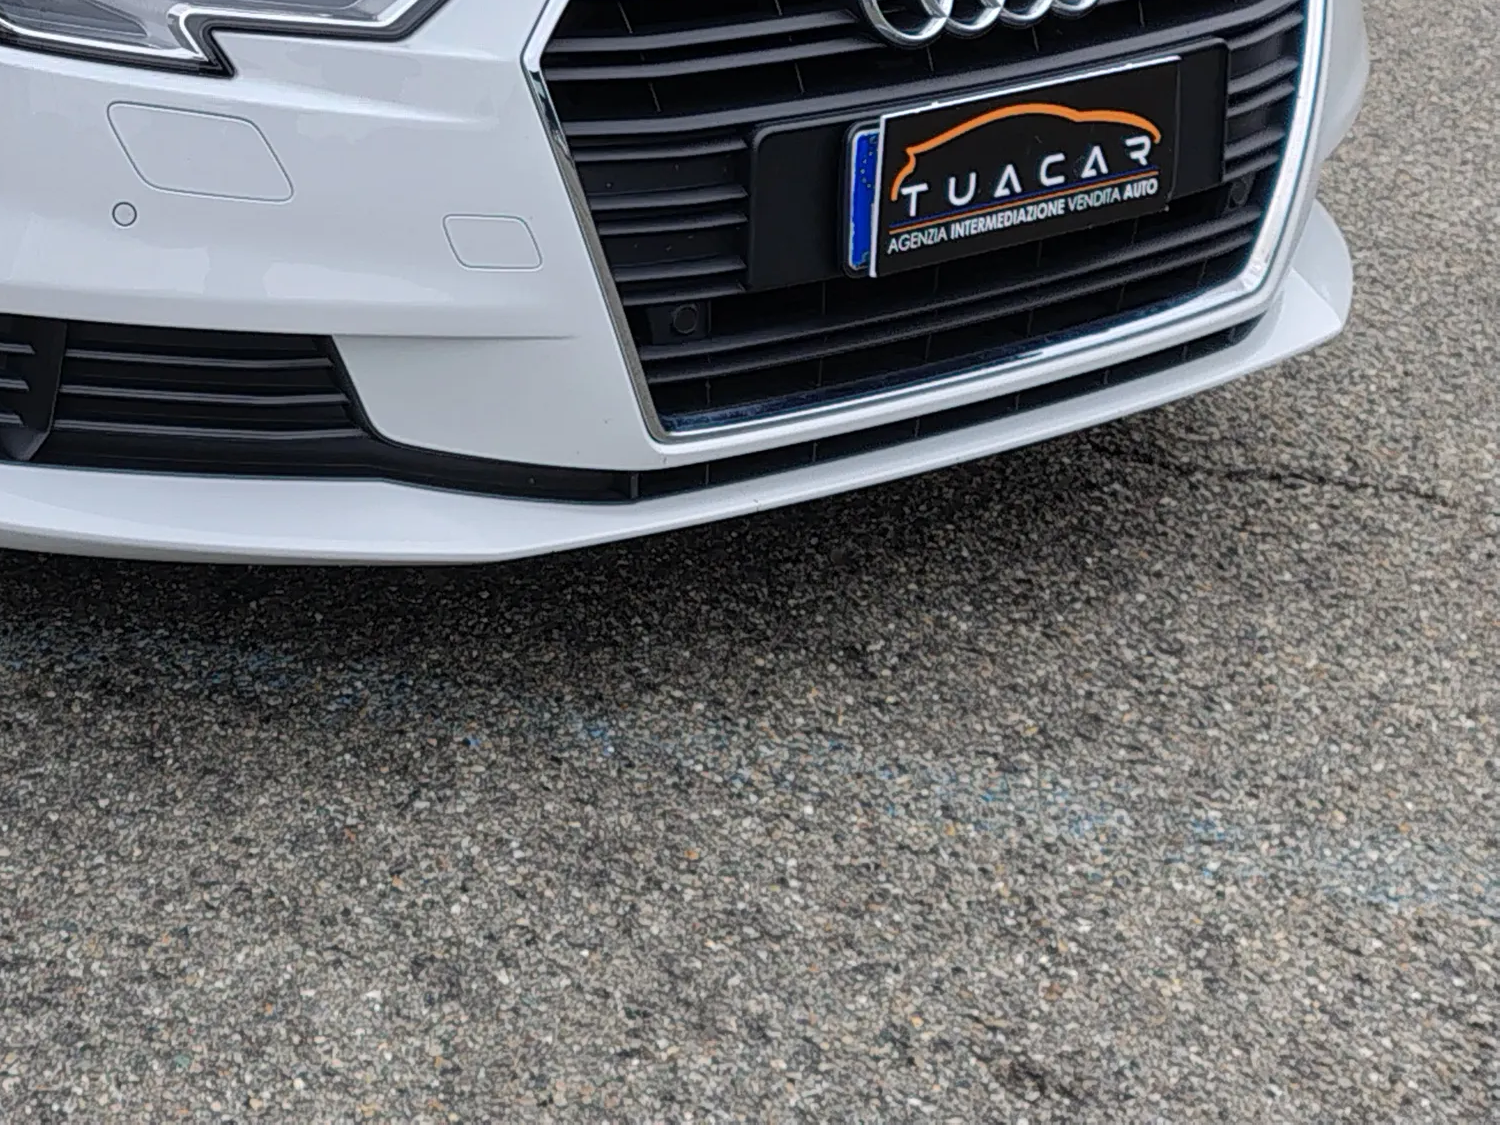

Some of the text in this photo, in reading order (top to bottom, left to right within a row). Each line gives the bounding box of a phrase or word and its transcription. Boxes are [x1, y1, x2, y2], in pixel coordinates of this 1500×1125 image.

[887, 177, 1159, 255] AGENZIA INTERMEDIAZIONE VENDITA AUTO
[901, 135, 1151, 217] TUACAR
